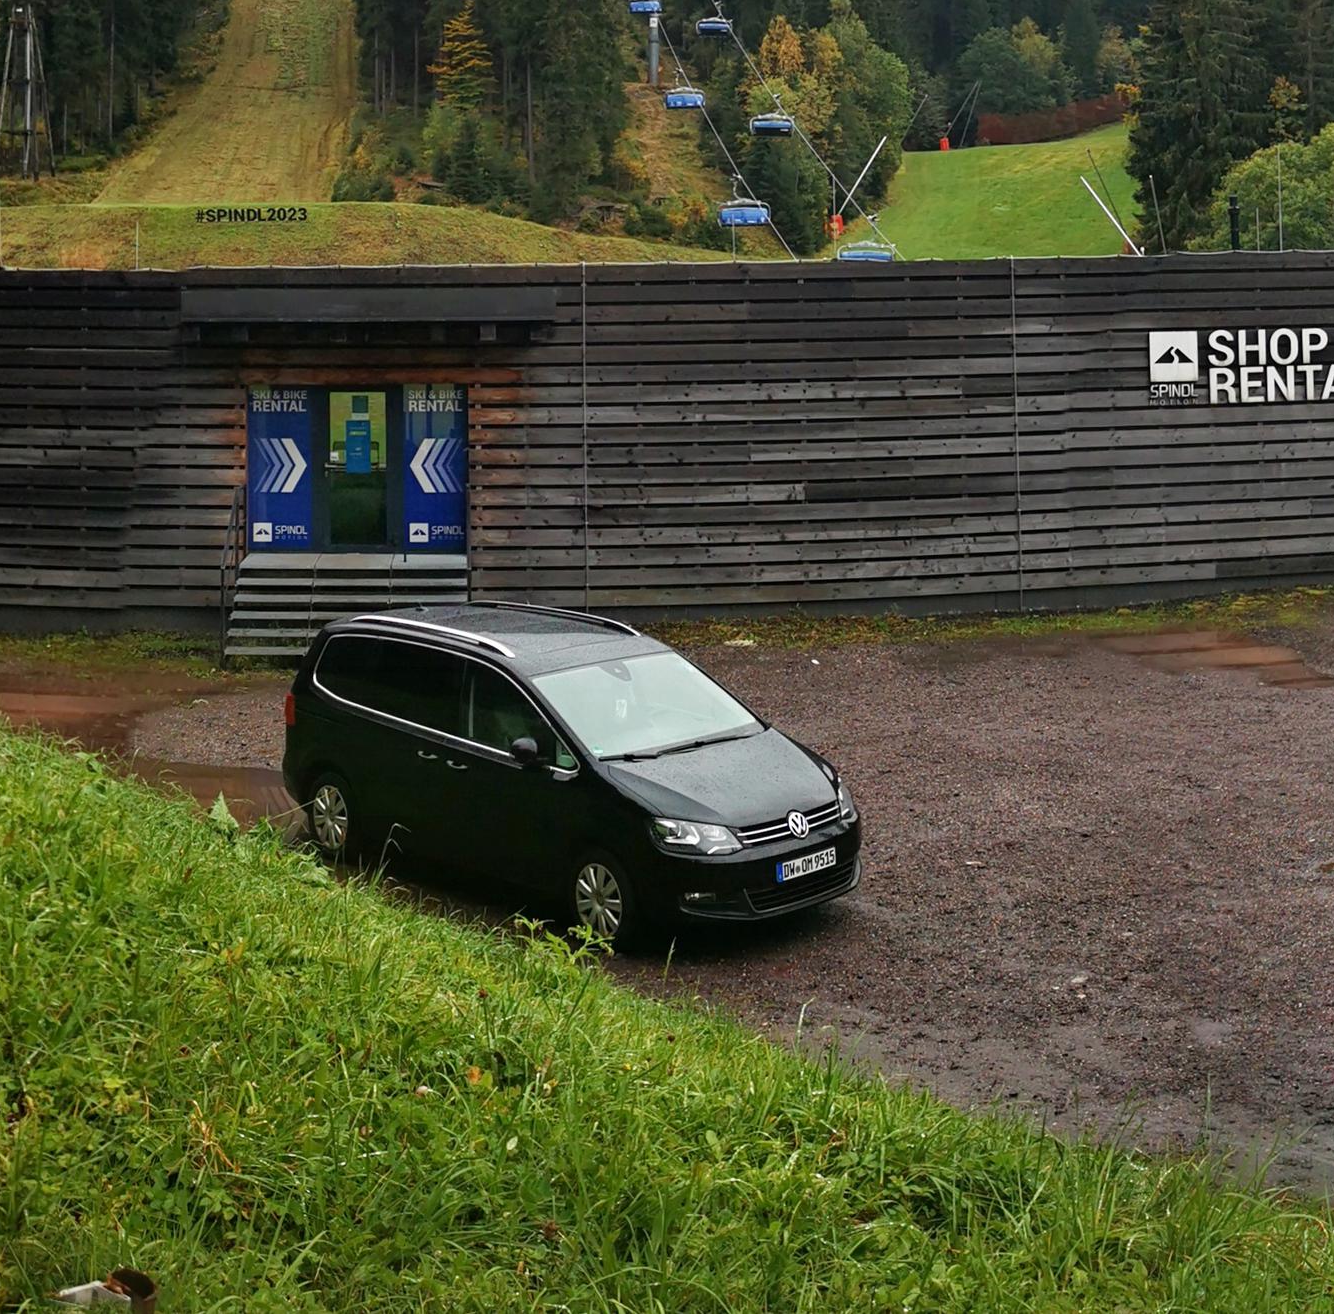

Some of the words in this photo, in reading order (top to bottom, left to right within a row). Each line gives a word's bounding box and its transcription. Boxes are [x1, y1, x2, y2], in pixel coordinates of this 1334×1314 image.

[196, 207, 308, 223] #SPINDL2023
[1207, 327, 1329, 367] SHOP
[252, 390, 270, 400] SKI
[272, 390, 281, 400] &
[283, 389, 307, 400] BIKE
[408, 390, 426, 399] SKI
[428, 390, 436, 399] &
[439, 389, 463, 399] BIKE
[1150, 383, 1199, 398] SPINDL
[252, 400, 307, 412] RENTAL
[408, 400, 463, 412] RENTAL
[274, 525, 308, 535] SPINDL
[430, 525, 464, 535] SPINDL
[784, 863, 795, 878] DW
[814, 849, 835, 870] 9515
